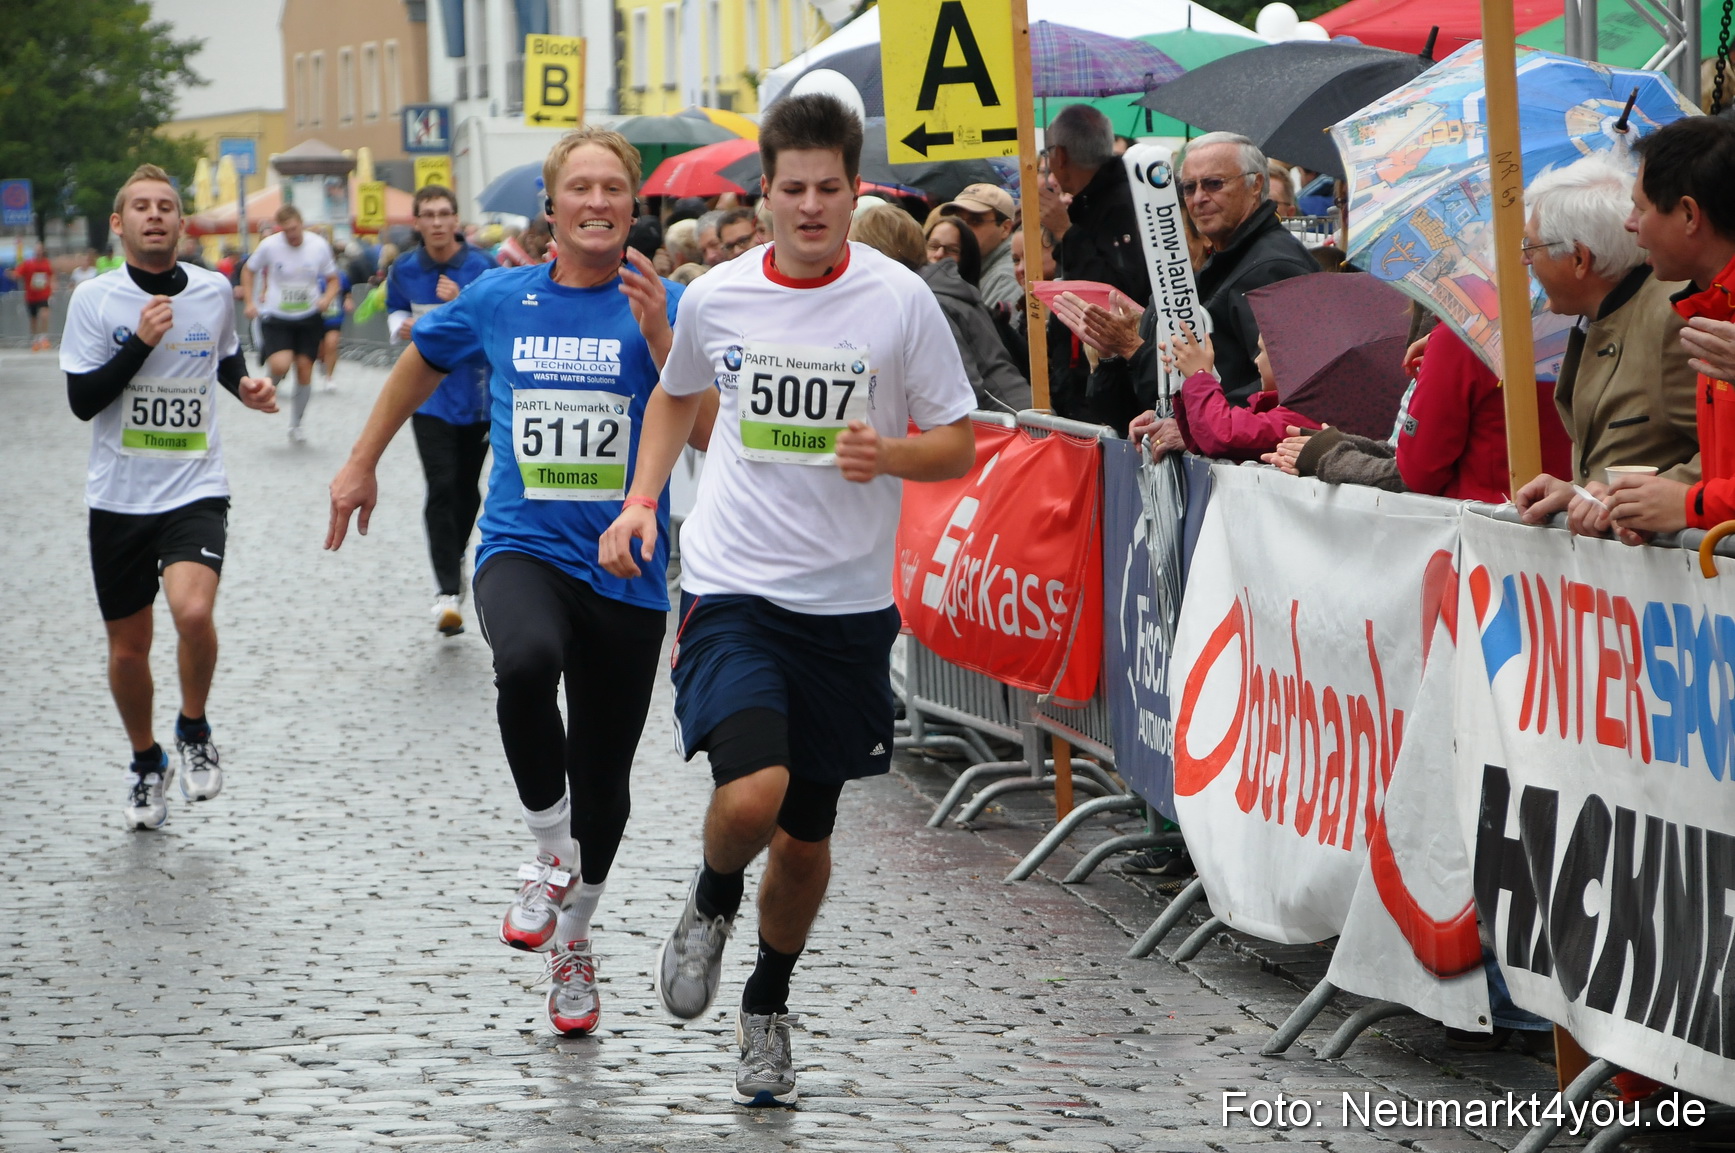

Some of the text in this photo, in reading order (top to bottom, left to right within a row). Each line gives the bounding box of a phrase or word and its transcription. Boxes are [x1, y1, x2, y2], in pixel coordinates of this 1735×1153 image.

[533, 38, 581, 57] Block
[916, 1, 1001, 111] A
[542, 64, 569, 107] B
[364, 195, 378, 216] D
[512, 336, 621, 362] HUBER
[534, 360, 616, 373] TECHNOLOGY
[744, 353, 846, 373] PARTL Neumarkt
[126, 384, 197, 394] PARTL Neumarkt
[533, 373, 616, 385] WASTE WATER Solutions
[750, 372, 856, 420] 5007
[131, 396, 202, 428] 5033
[515, 400, 610, 413] PARTL Neumarkt
[143, 434, 188, 448] Thomas
[522, 417, 619, 458] 5112
[771, 429, 827, 449] Tobias
[537, 468, 599, 485] Thomas
